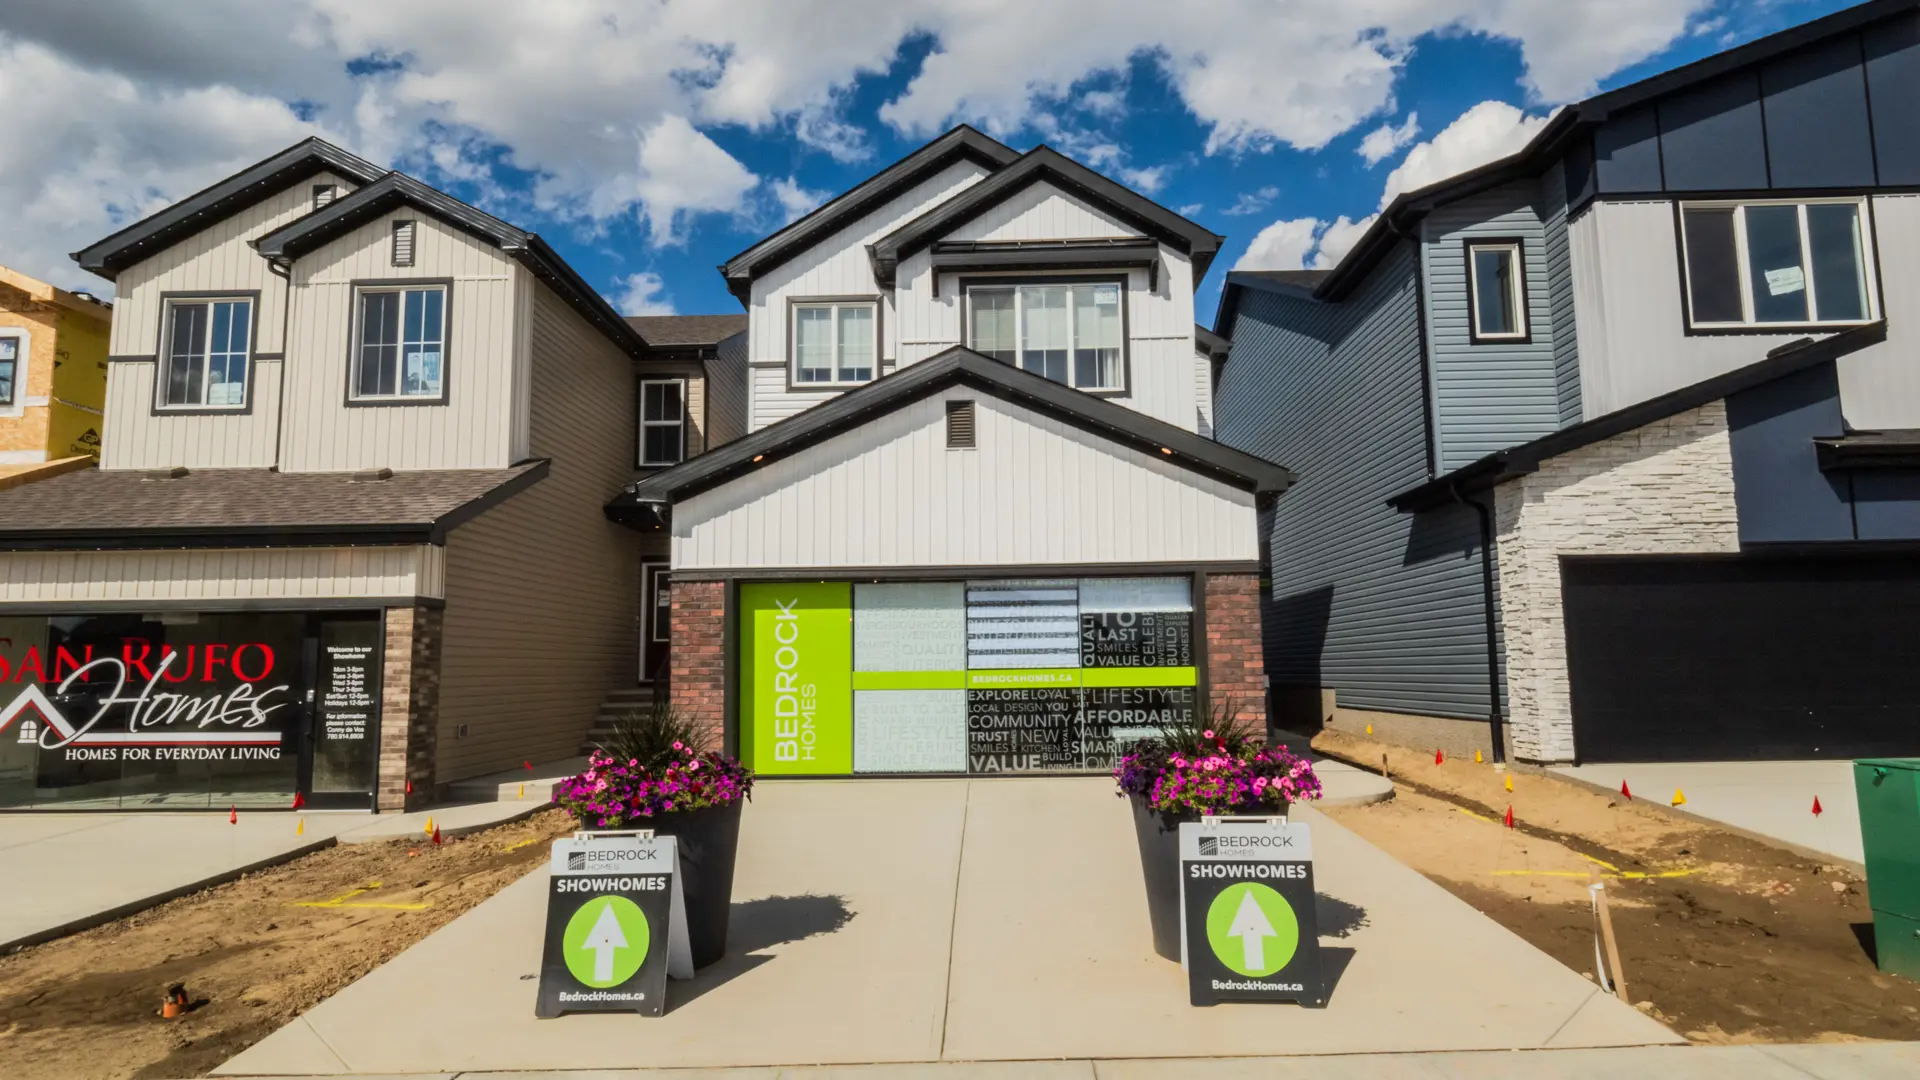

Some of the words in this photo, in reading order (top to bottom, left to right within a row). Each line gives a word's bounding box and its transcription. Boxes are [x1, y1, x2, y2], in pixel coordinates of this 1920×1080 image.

[1098, 628, 1138, 641] LAST
[1097, 643, 1138, 653] SMILES
[1166, 626, 1178, 666] BUILD
[1180, 627, 1190, 666] HONEST
[120, 636, 275, 682] RUFO
[1098, 655, 1140, 667] VALUE
[775, 598, 798, 761] BEDROCK
[972, 674, 1073, 683] BEDROCKHOMES.CA
[39, 651, 289, 749] Homes
[968, 690, 1029, 701] EXPLORE
[1031, 689, 1071, 699] LOYAL
[1092, 687, 1192, 704] LIFESTYLE
[968, 703, 1000, 713] LOCAL
[1004, 703, 1042, 712] DESIGN
[1046, 702, 1069, 711] YOU
[801, 683, 816, 760] HOMES
[968, 714, 1072, 728] COMMUNITY
[1073, 709, 1192, 724] AFFORDABLE
[970, 731, 1009, 742] TRUST
[1020, 729, 1059, 743] NEW
[66, 749, 117, 760] HOMES
[122, 748, 151, 760] FOR
[155, 748, 229, 760] EVERYDAY
[230, 747, 281, 760] LIVING
[971, 744, 1009, 753] SMILES
[1020, 744, 1061, 752] KITCHEN
[1071, 741, 1124, 753] SMART
[970, 754, 1041, 772] VALUE
[1042, 752, 1072, 761] BUILD
[1220, 836, 1294, 847] BEDROCK
[588, 849, 657, 862] BEDROCK
[1220, 849, 1255, 857] HOMES
[587, 863, 620, 871] HOMES
[1190, 864, 1307, 879] SHOWHOMES
[557, 877, 666, 893] SHOWHOMES
[1211, 979, 1303, 991] BedrockHomes.ca
[559, 991, 645, 1002] BedrockHomes.ca
